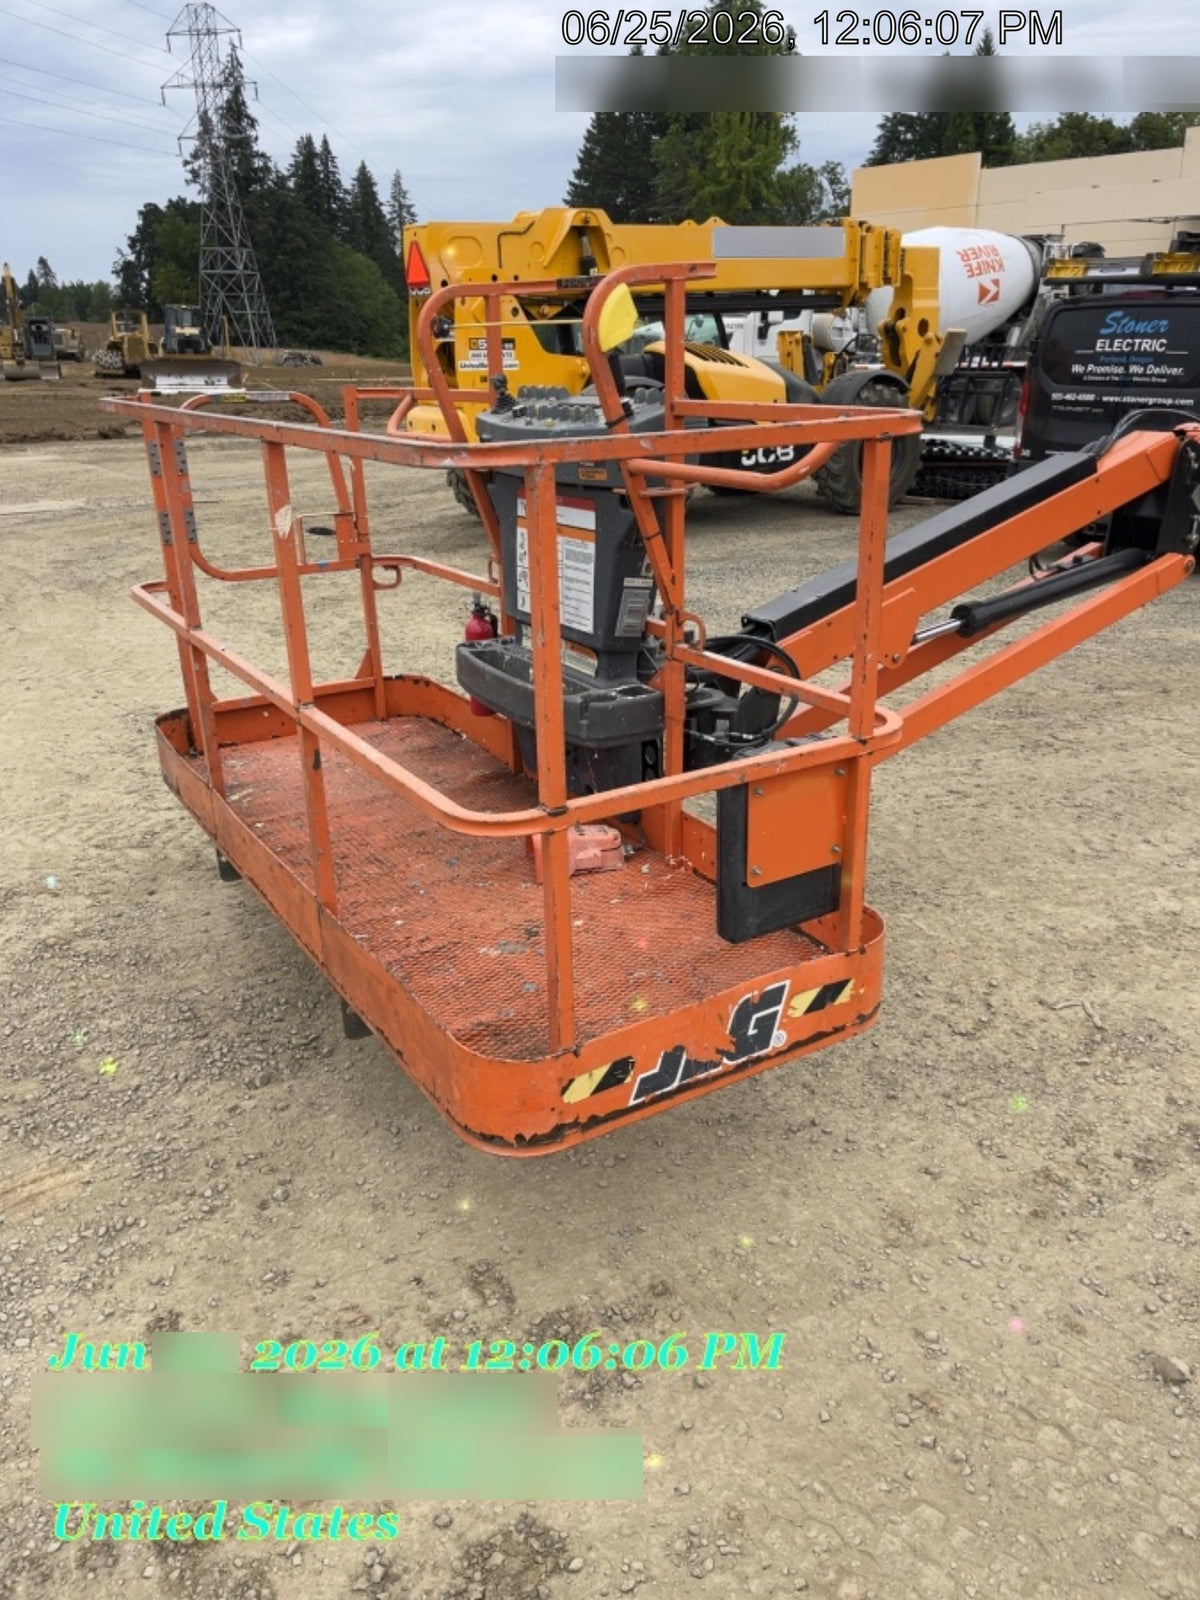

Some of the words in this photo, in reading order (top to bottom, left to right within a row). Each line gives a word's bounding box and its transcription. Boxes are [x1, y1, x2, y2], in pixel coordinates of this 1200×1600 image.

[955, 245, 1000, 261] RIVER
[963, 258, 1005, 278] KNIFE
[1099, 310, 1169, 335] Stoner
[1095, 338, 1168, 352] ELECTRIC
[1072, 363, 1085, 374] We
[1086, 363, 1127, 374] Promise.
[1128, 363, 1144, 374] We
[1146, 364, 1185, 376] Deliver.
